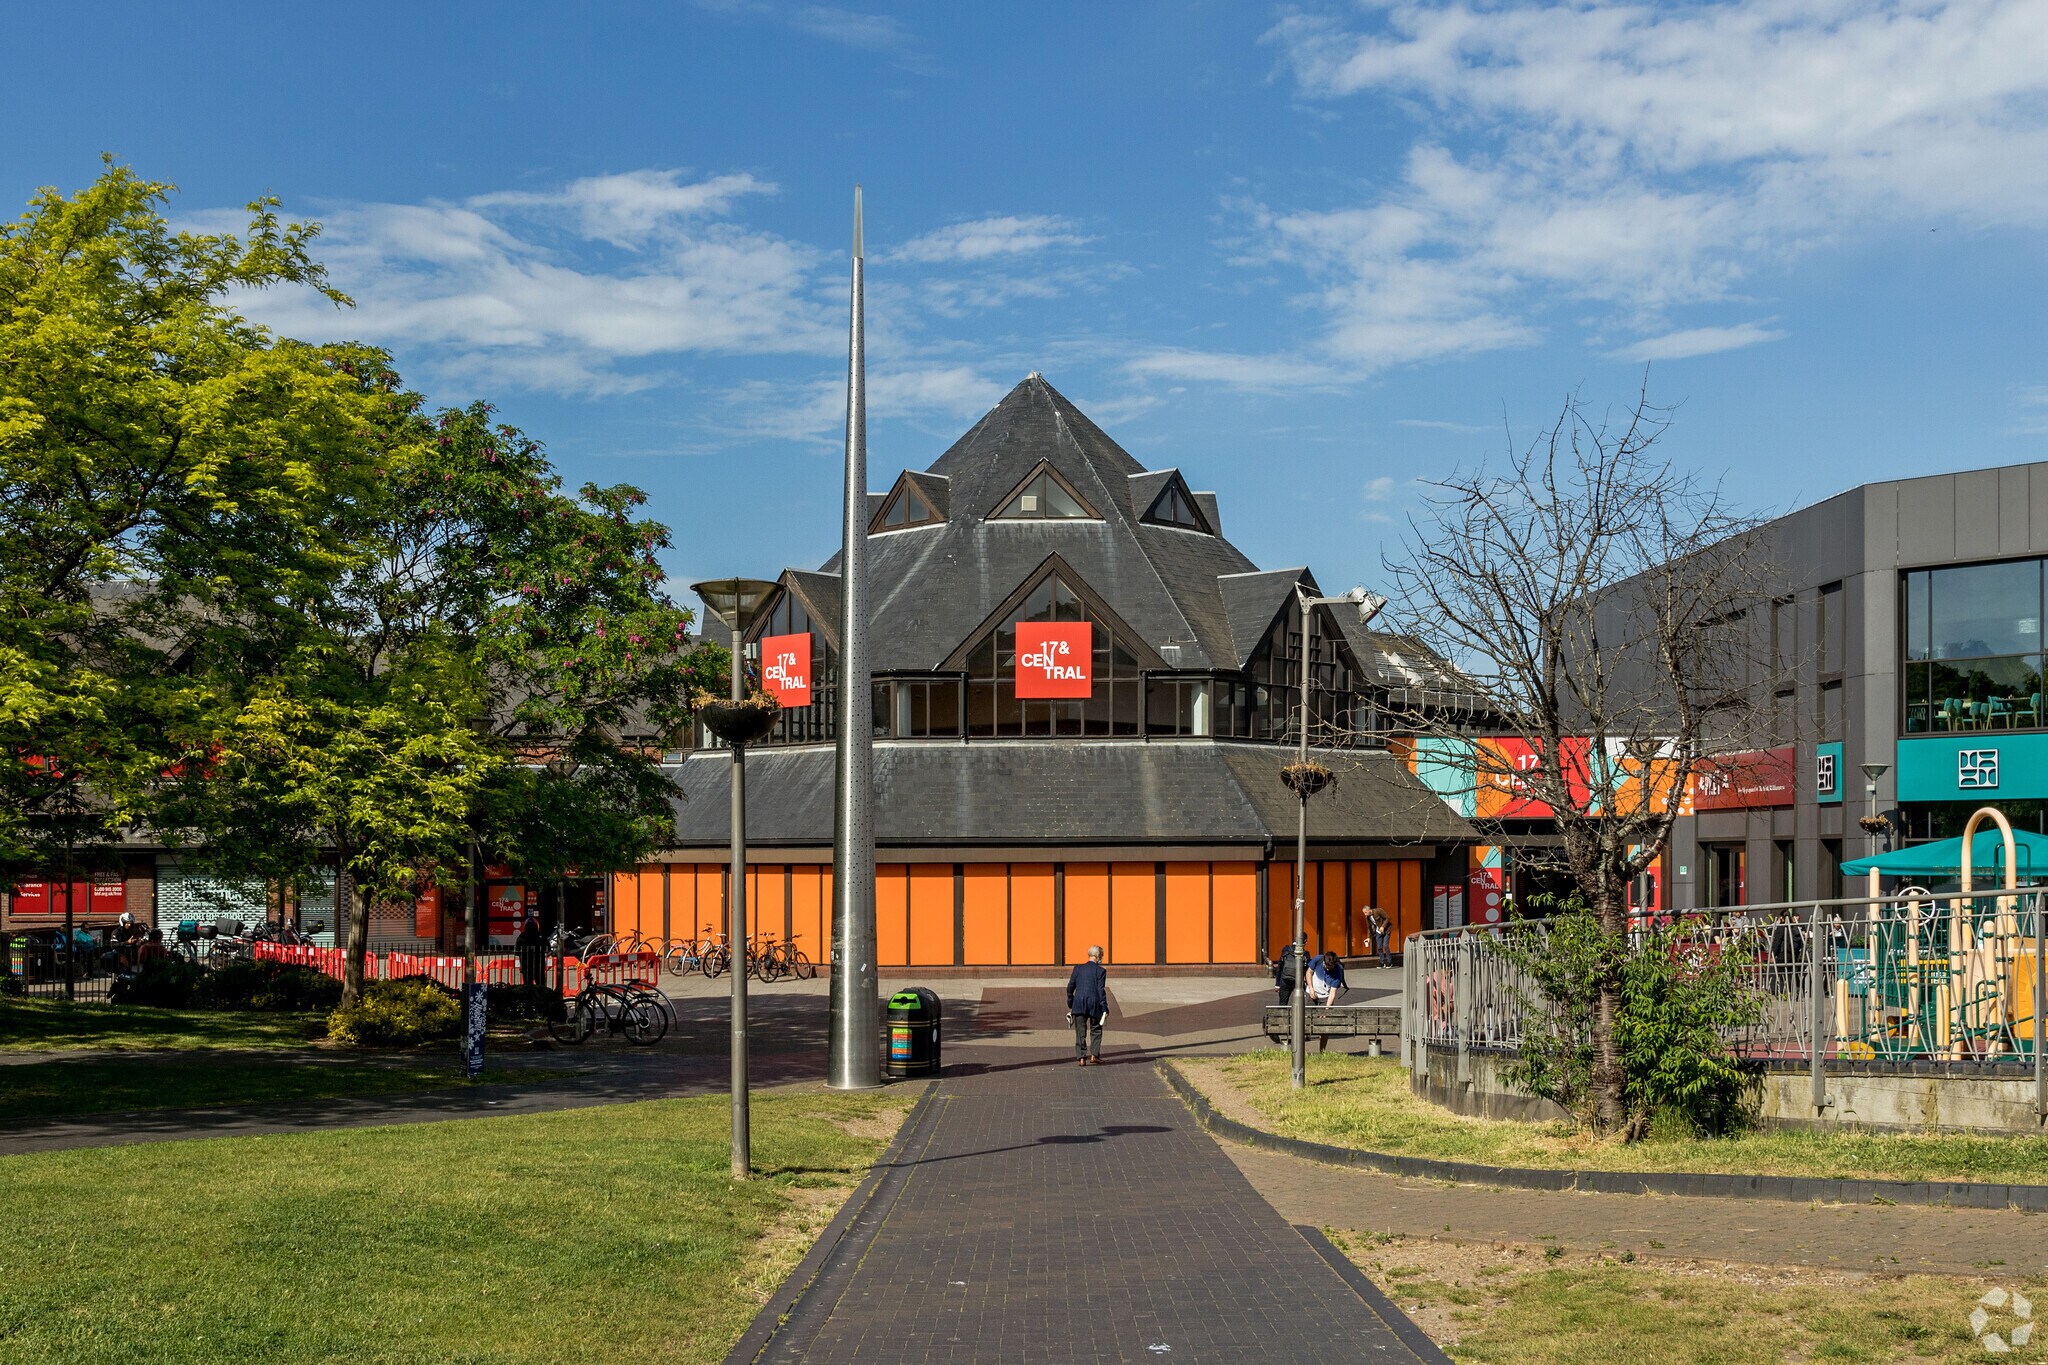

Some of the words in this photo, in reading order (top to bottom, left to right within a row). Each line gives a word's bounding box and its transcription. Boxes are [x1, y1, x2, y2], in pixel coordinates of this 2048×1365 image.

[1040, 641, 1070, 655] 17&
[777, 652, 797, 666] 17&
[1021, 653, 1054, 668] CEN
[765, 665, 787, 680] CEN
[1043, 665, 1086, 680] TRAL
[779, 675, 806, 690] TRAL
